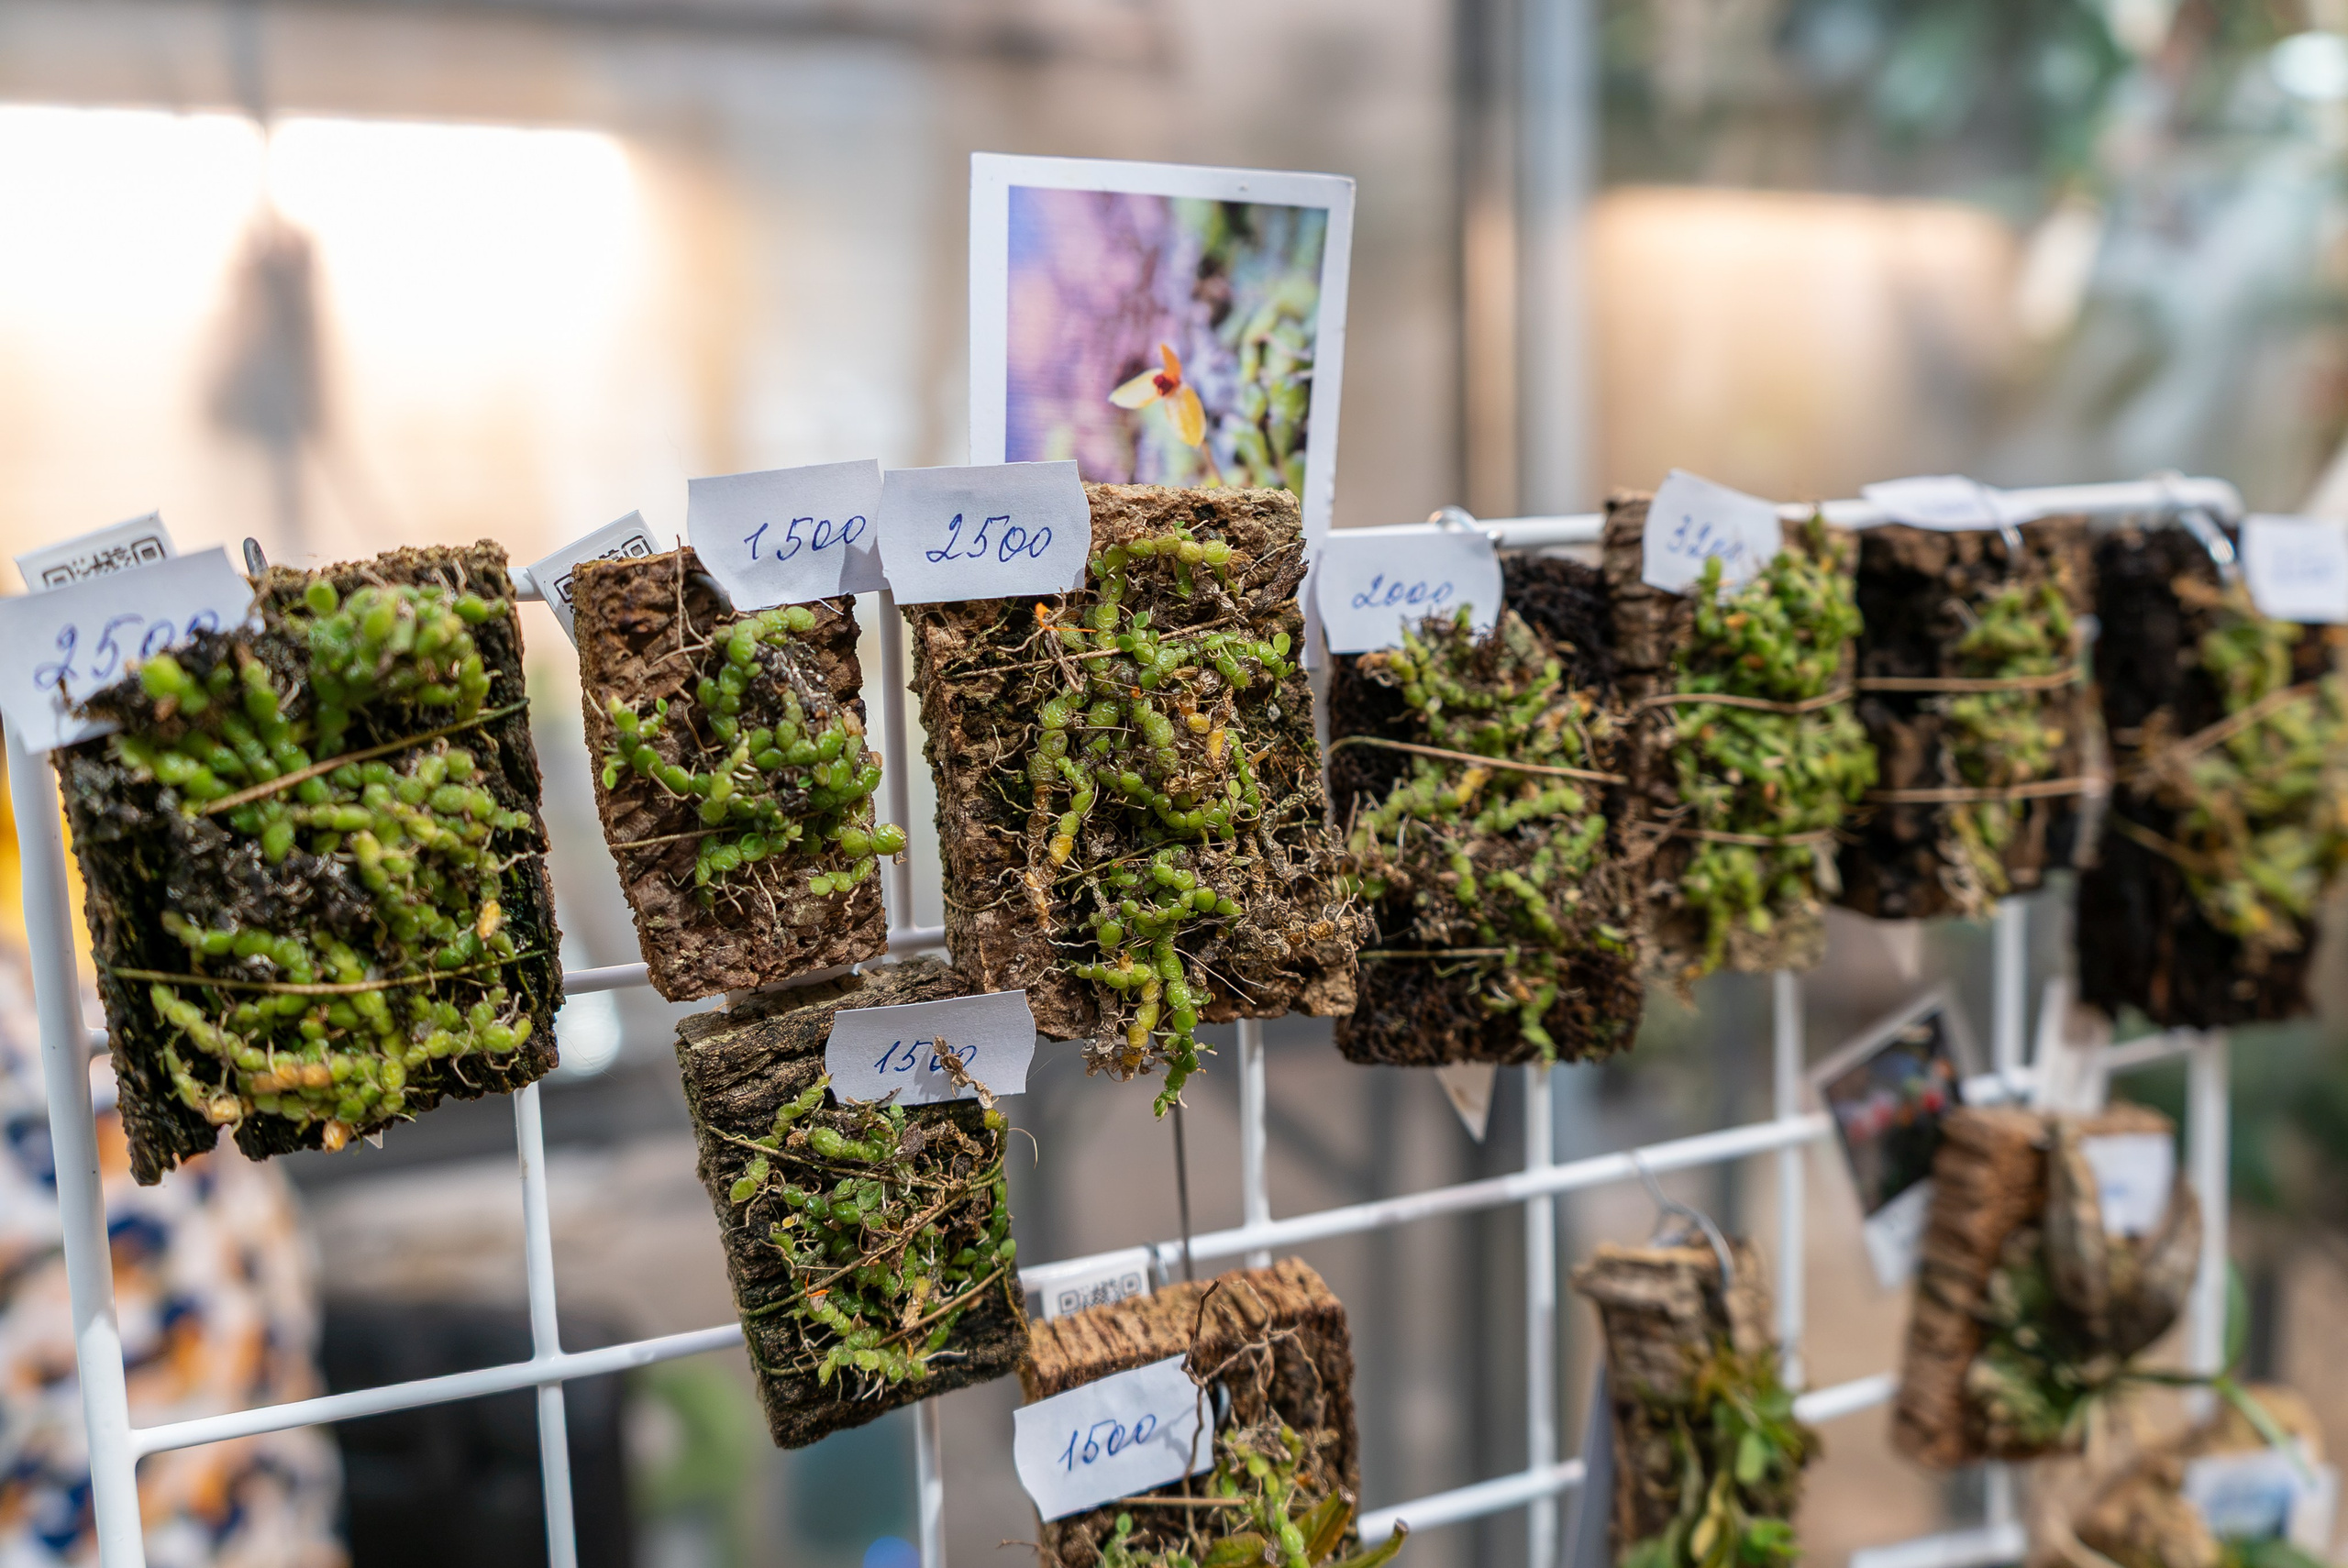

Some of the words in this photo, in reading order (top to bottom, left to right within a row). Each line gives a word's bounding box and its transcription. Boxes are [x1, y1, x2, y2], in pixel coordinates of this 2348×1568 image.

[744, 514, 866, 561] 1500
[925, 513, 1052, 563] 2500
[1351, 572, 1454, 610] 2000
[1058, 1413, 1157, 1471] 1500
